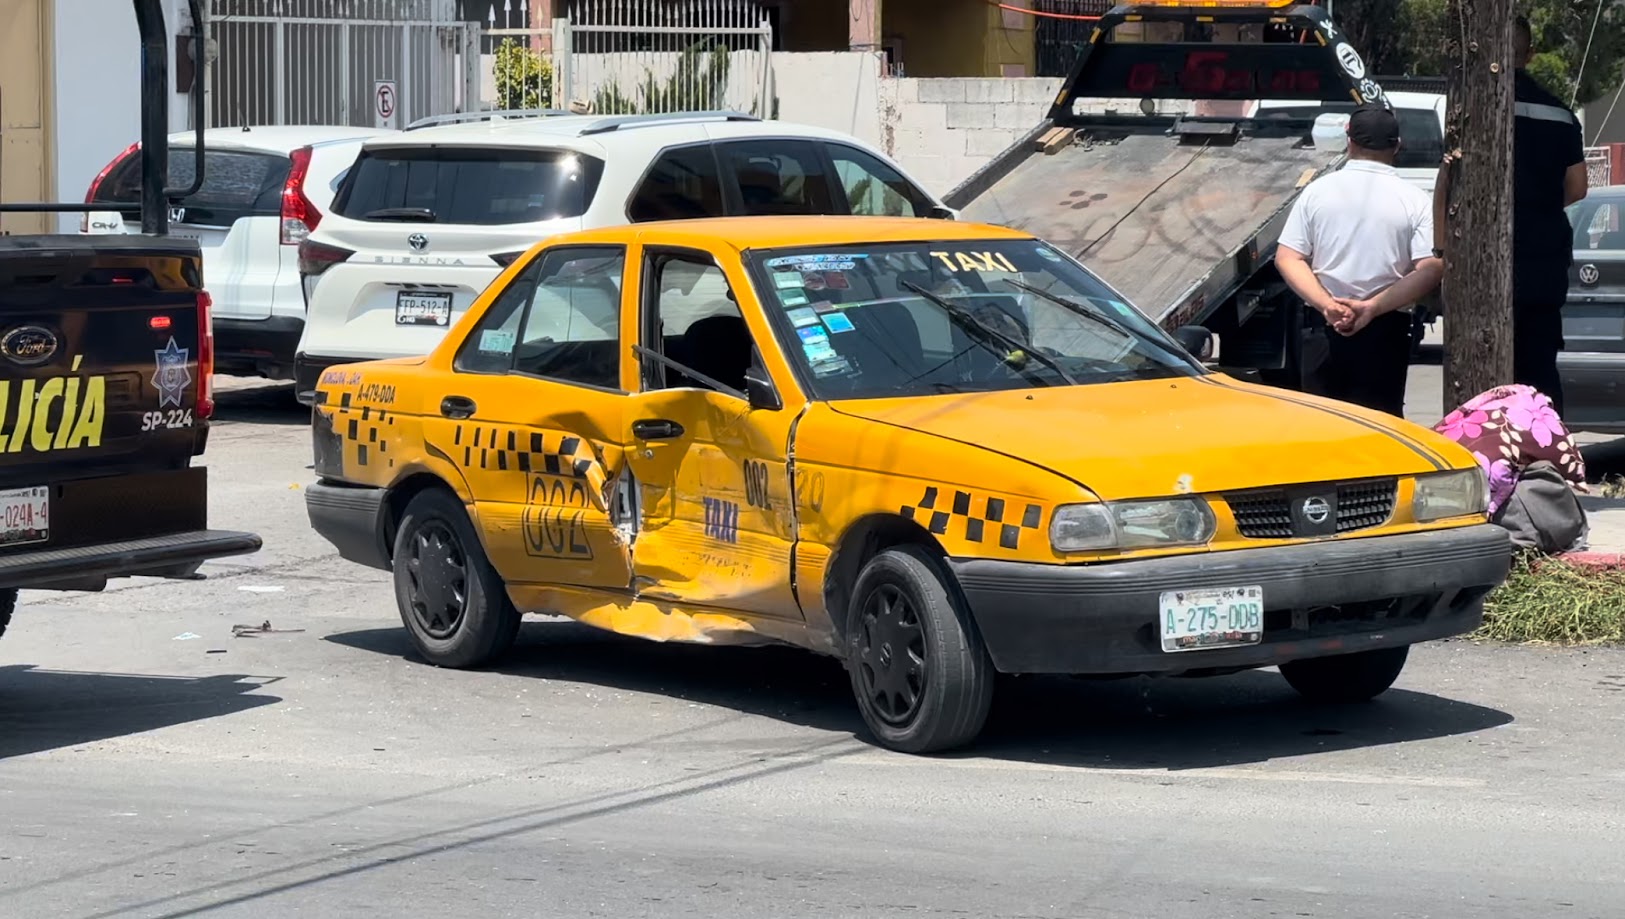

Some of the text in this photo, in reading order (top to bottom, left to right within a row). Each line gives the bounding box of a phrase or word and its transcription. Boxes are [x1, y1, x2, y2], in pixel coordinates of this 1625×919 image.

[374, 256, 465, 266] SIENNA
[930, 251, 1018, 273] TAXI
[16, 334, 47, 355] Ford
[141, 407, 193, 431] SP-224
[743, 458, 772, 511] 002
[525, 476, 589, 554] 002
[702, 495, 739, 545] TAXI
[1165, 603, 1259, 635] A-275-DDB
